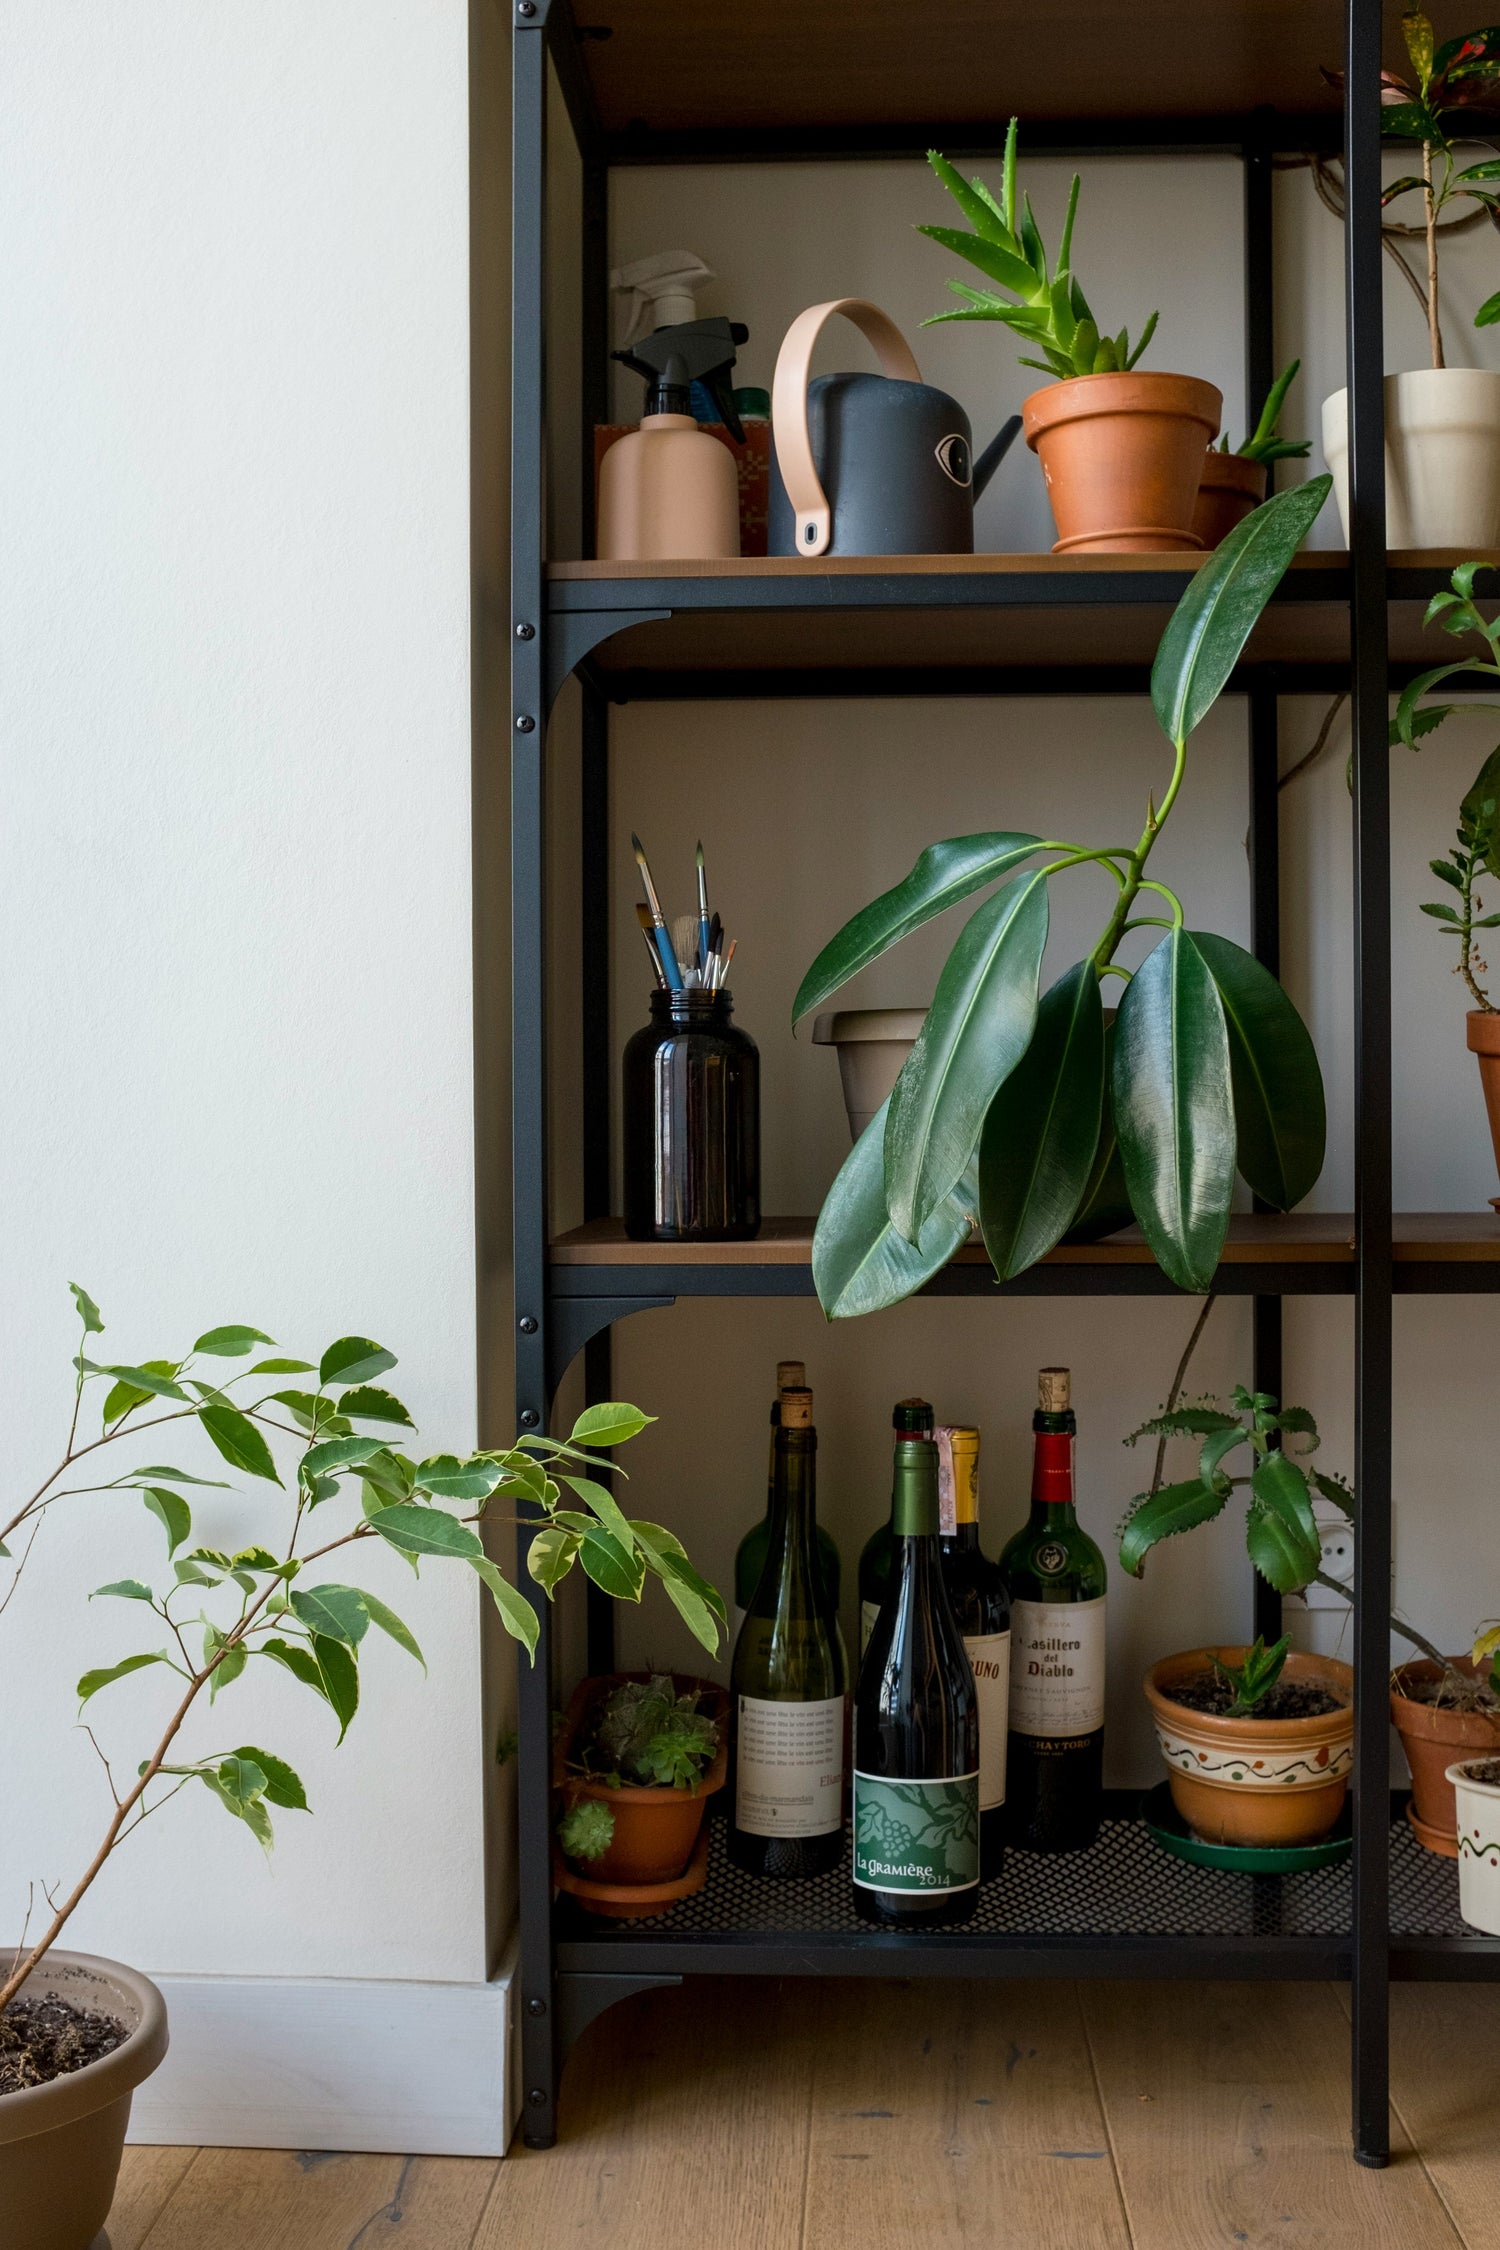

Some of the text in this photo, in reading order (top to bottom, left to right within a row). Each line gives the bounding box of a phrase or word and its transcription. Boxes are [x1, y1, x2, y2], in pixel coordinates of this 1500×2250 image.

[1019, 1638, 1081, 1651] asillero
[1044, 1654, 1058, 1663] del
[1027, 1661, 1074, 1678] Diablo
[1062, 1739, 1091, 1750] TORO
[857, 1852, 867, 1870] La
[919, 1874, 950, 1887] 2014
